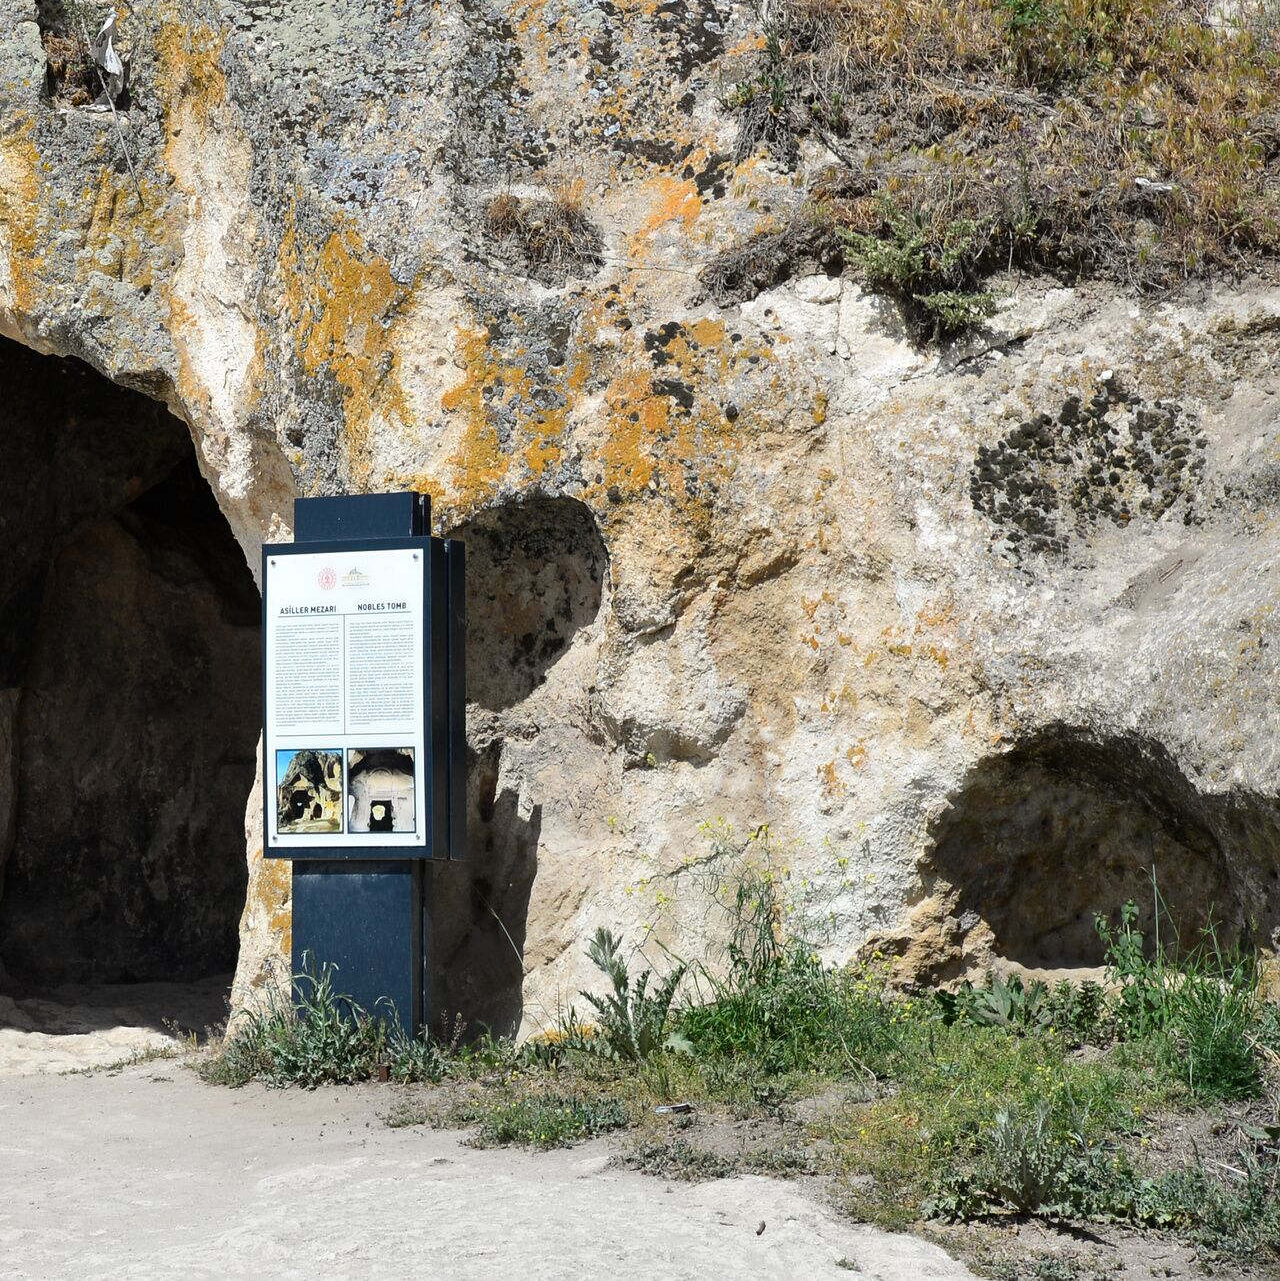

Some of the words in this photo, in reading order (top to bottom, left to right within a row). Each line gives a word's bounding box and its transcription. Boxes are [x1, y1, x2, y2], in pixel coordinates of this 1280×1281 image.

[280, 606, 309, 615] ASİLLER
[310, 605, 337, 614] MEZARI
[357, 603, 385, 611] NOBLES
[387, 602, 407, 610] TOMB
